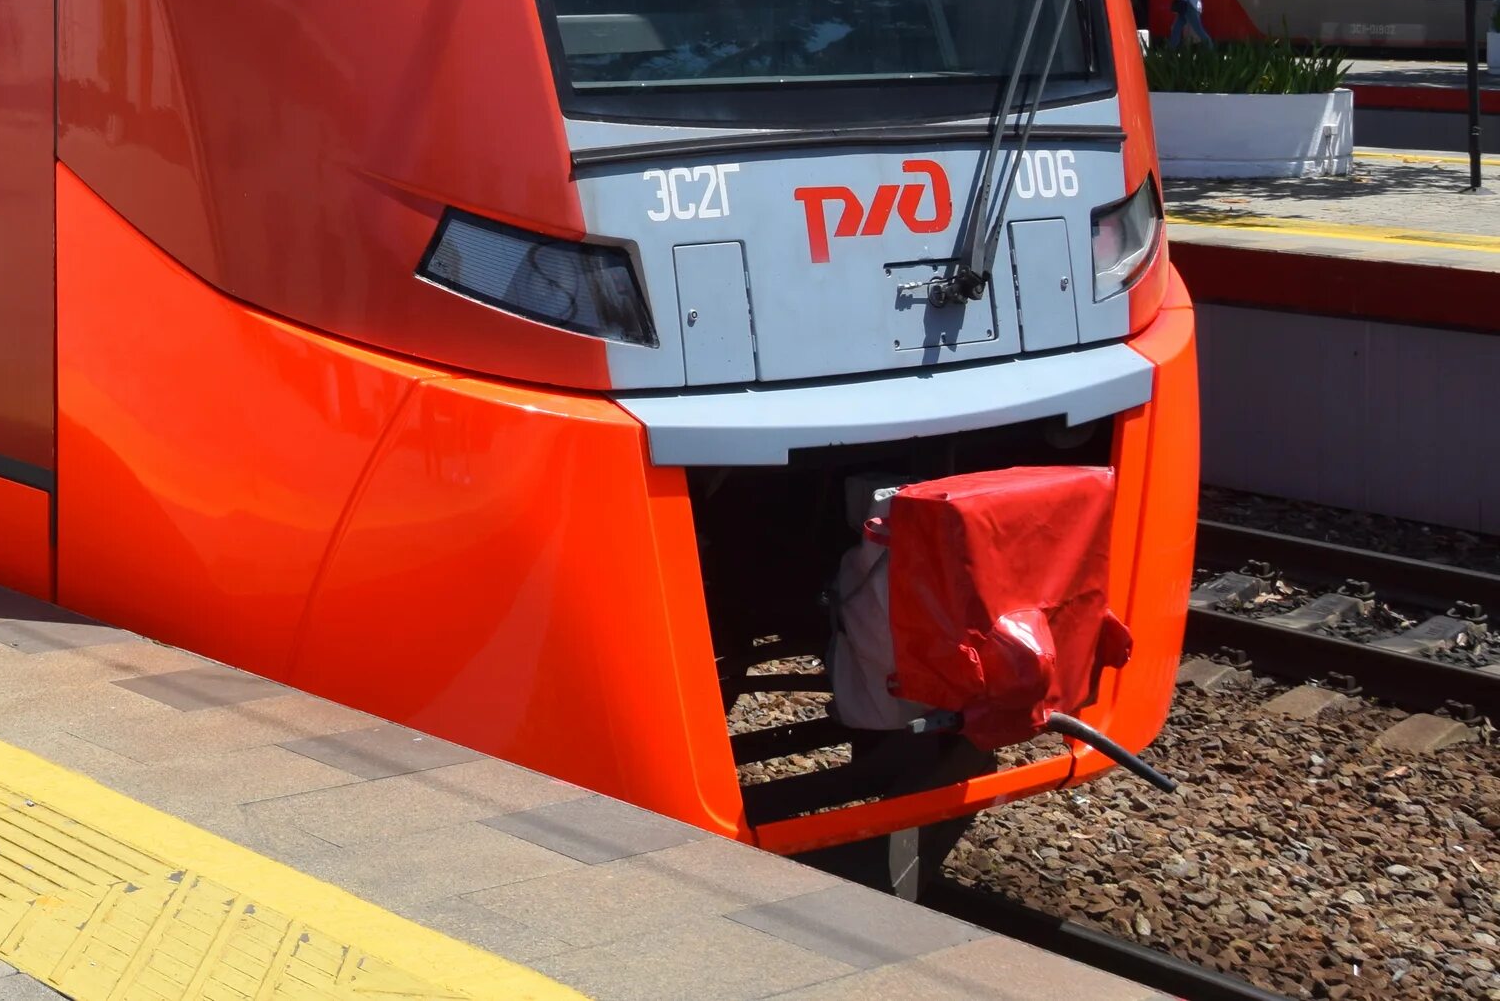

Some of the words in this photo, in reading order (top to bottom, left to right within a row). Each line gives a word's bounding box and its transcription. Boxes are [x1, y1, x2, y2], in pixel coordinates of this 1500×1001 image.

[642, 163, 740, 222] ЭС2Г
[1012, 149, 1079, 199] 006
[794, 159, 953, 264] РЖД
